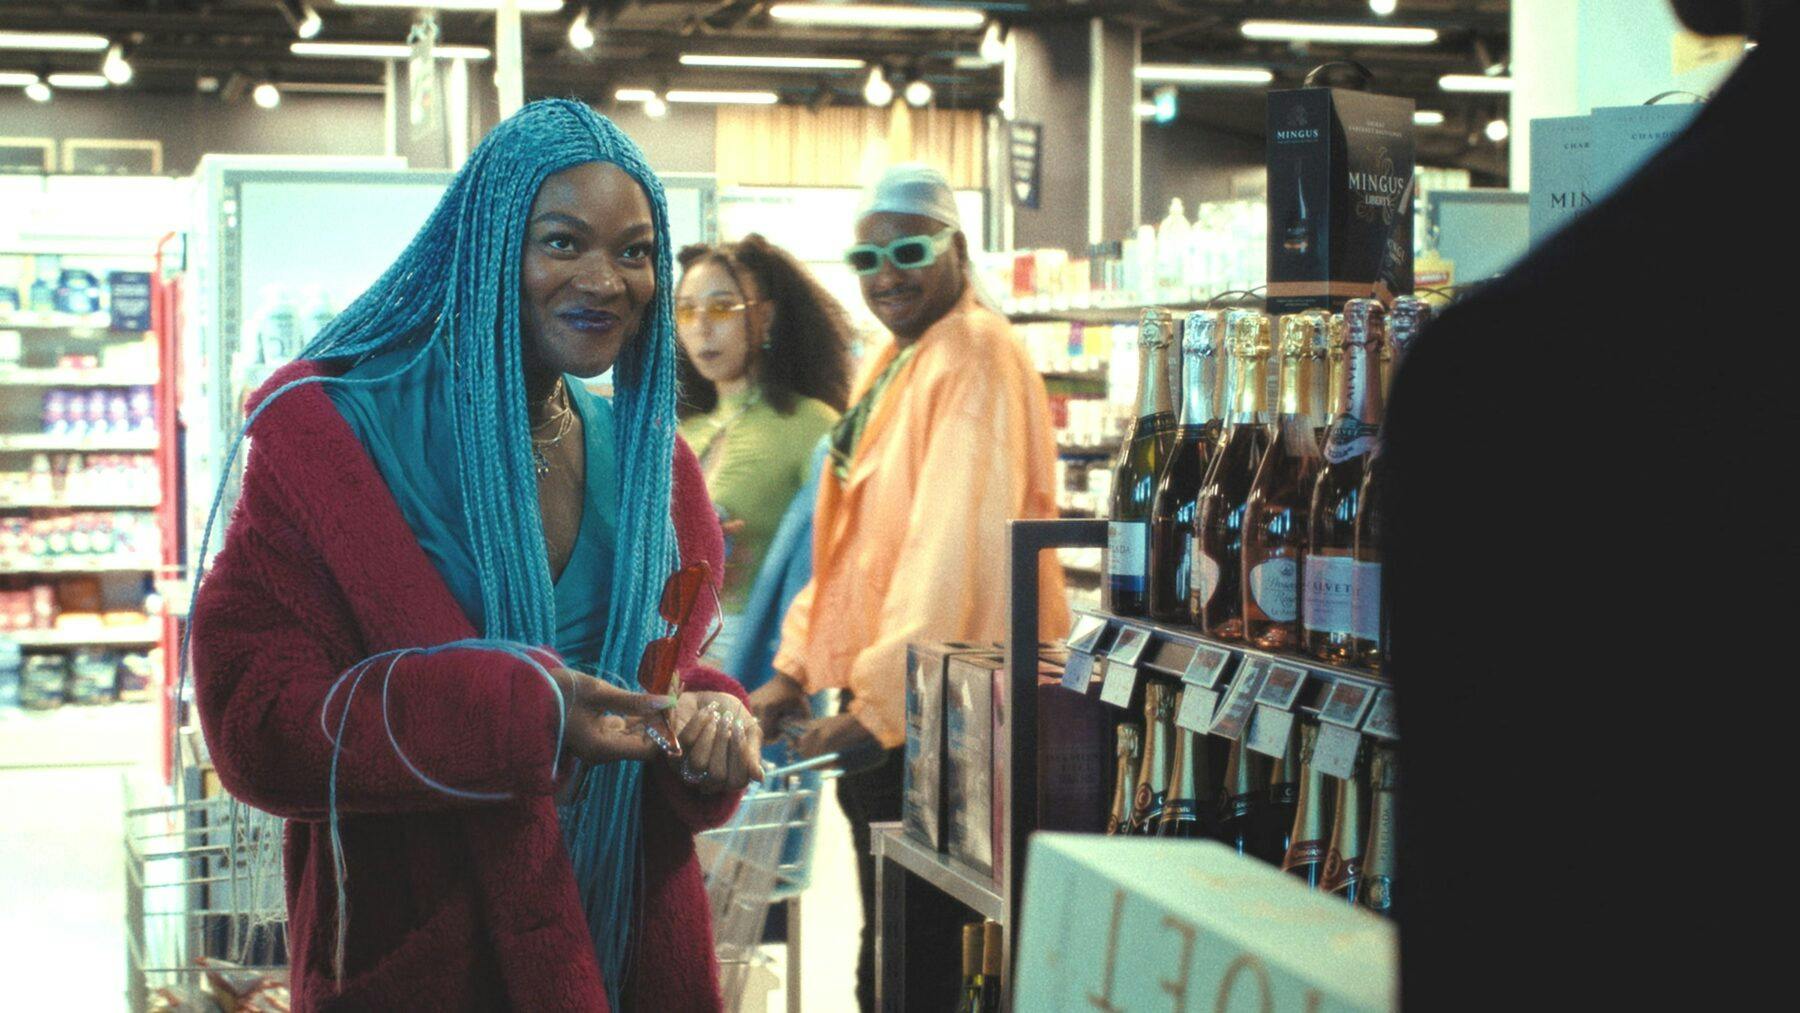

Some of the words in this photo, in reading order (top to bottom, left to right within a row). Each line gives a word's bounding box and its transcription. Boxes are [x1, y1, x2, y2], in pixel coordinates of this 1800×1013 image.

[1276, 129, 1319, 140] MINGUS
[1348, 172, 1404, 194] MINGUS
[1087, 888, 1322, 1013] OET
